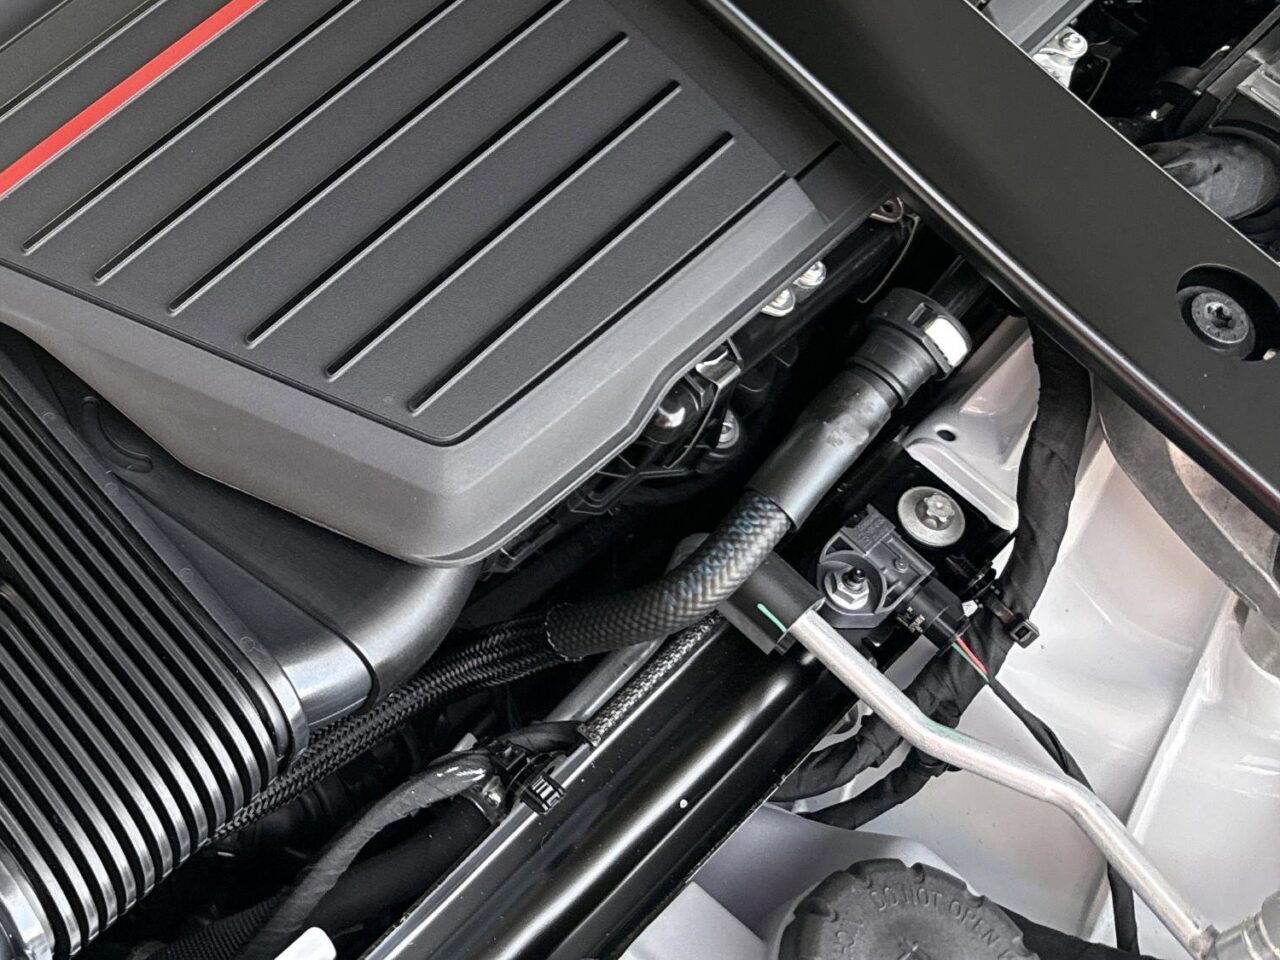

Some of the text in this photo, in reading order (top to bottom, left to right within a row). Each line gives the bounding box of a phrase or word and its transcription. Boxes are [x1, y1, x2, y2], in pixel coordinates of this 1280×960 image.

[870, 884, 1000, 947] DO NOT OPEN
